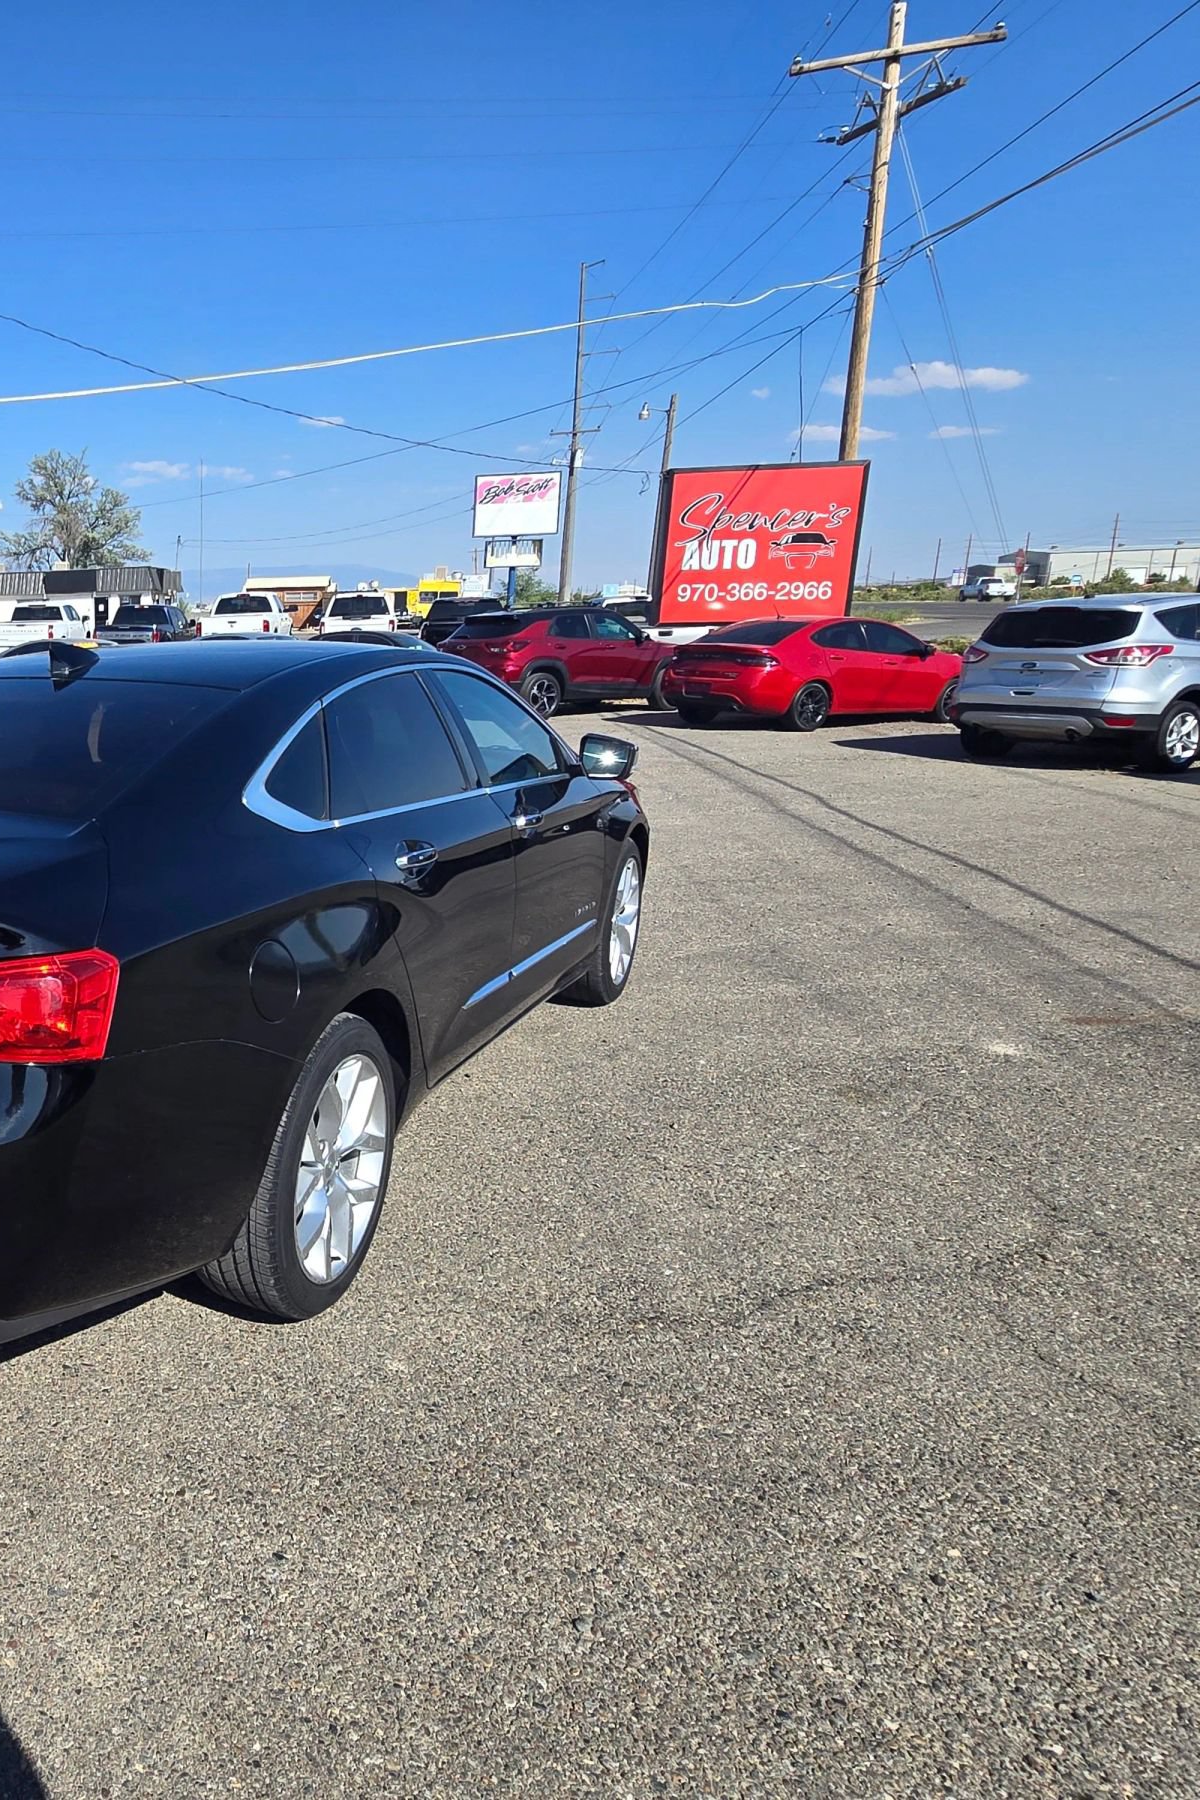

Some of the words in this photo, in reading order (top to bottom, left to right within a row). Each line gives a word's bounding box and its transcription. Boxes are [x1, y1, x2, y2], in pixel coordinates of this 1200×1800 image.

[479, 480, 515, 504] Bob
[516, 477, 554, 495] Scott
[675, 493, 851, 551] Spencer's
[681, 538, 757, 571] AUTO
[677, 581, 833, 602] 970-366-2966
